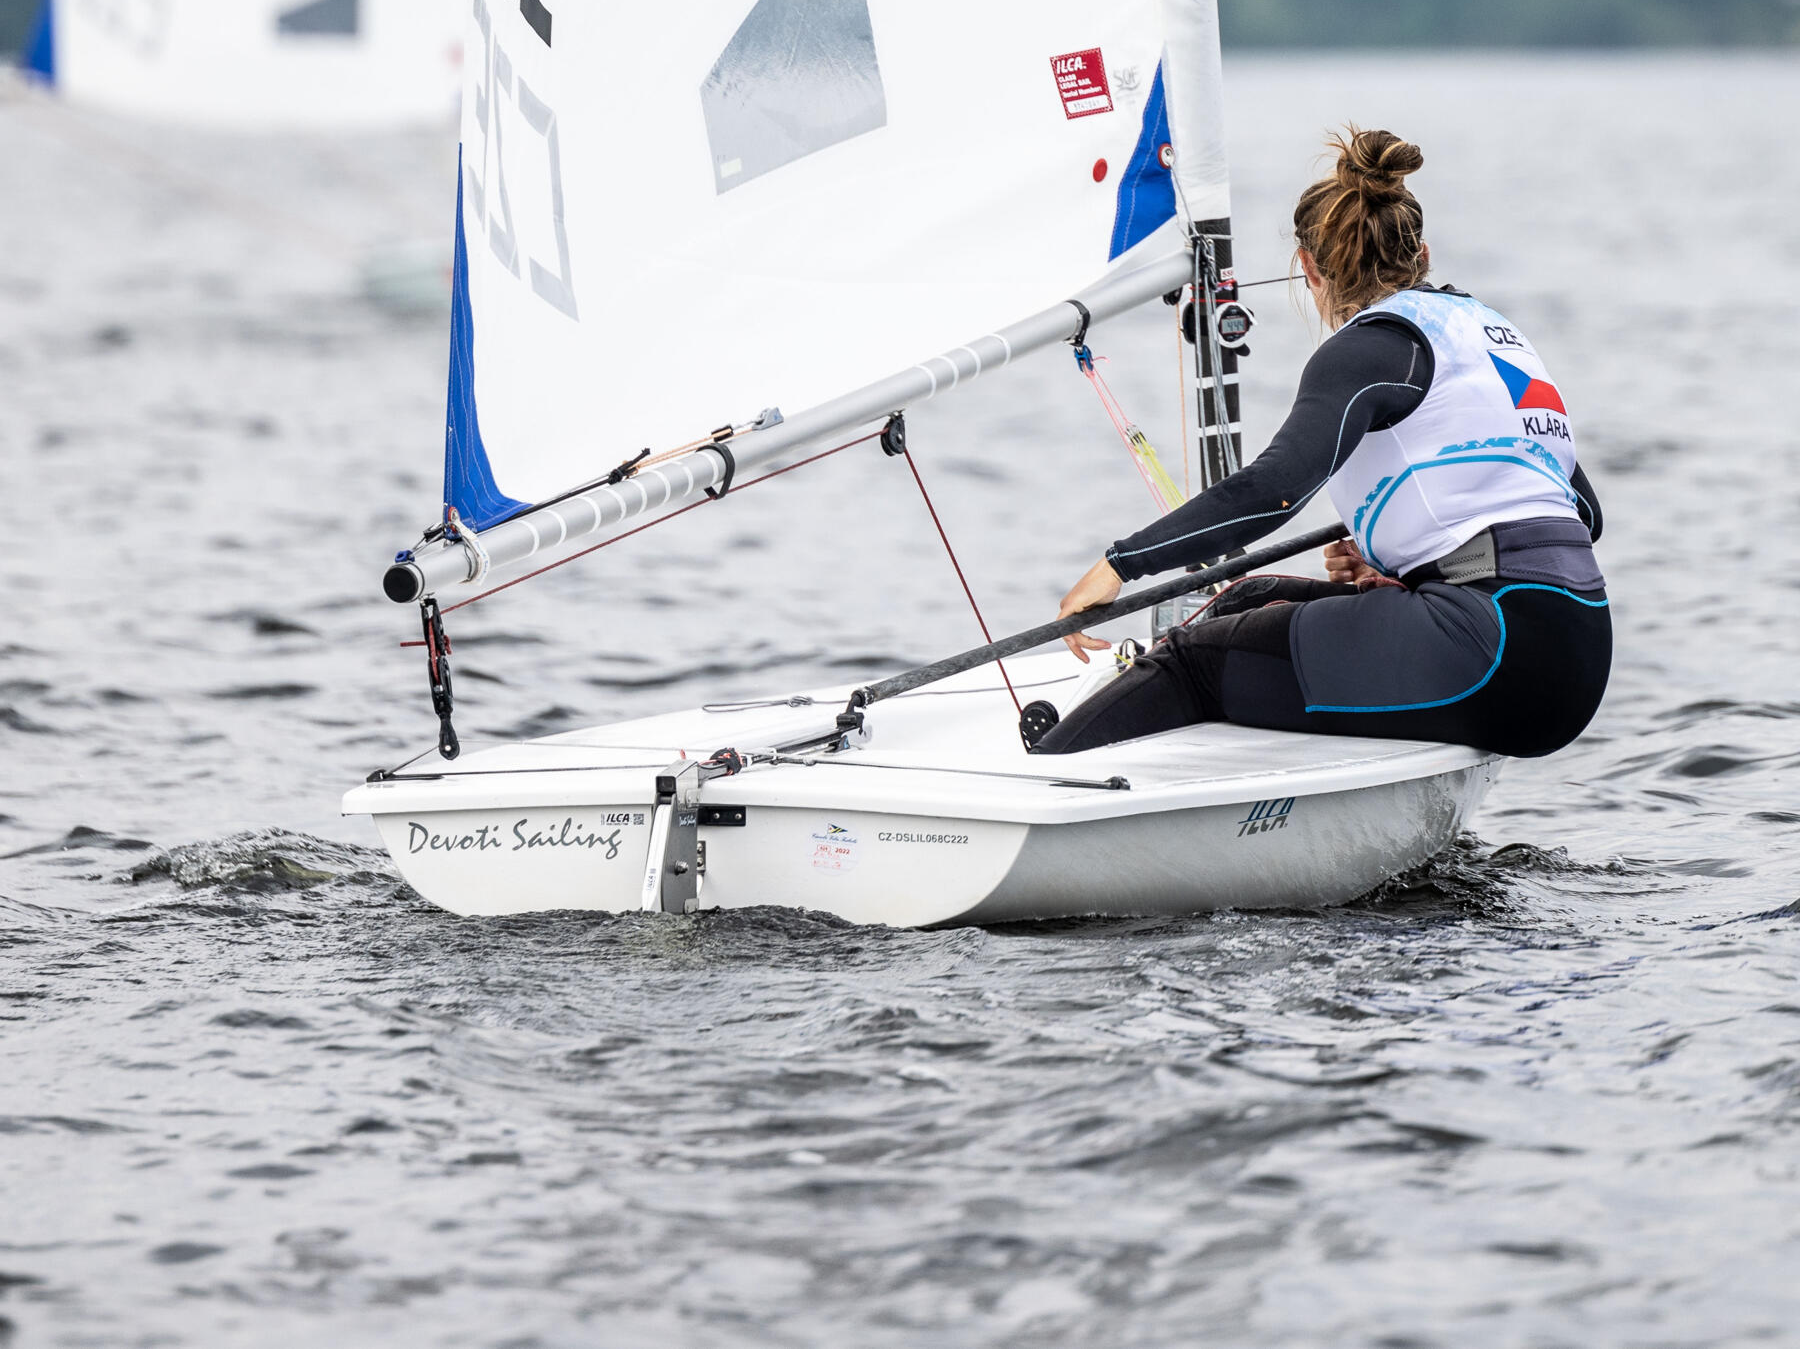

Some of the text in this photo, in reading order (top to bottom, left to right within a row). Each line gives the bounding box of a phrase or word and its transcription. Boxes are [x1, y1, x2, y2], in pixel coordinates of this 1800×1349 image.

[1484, 326, 1524, 347] CZE
[1523, 413, 1571, 442] KLÁRA
[606, 813, 630, 823] ILCA
[408, 817, 622, 860] Devoti Sailing
